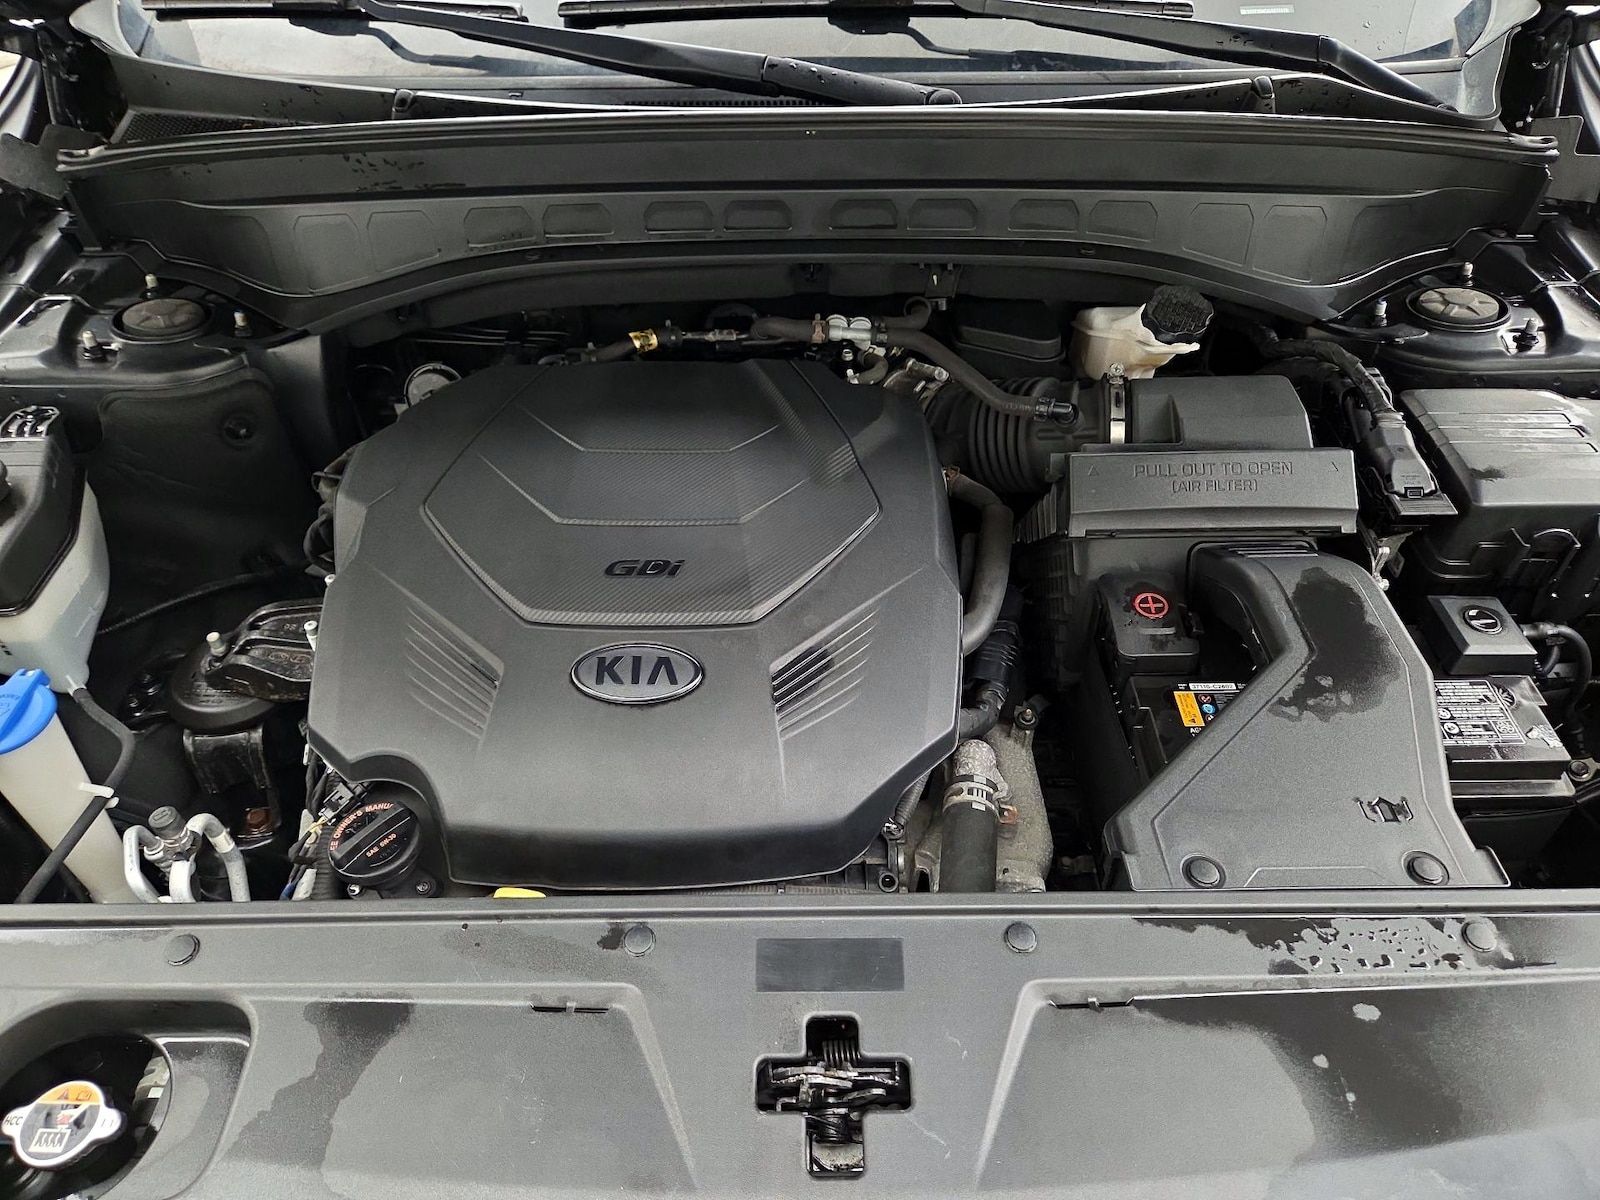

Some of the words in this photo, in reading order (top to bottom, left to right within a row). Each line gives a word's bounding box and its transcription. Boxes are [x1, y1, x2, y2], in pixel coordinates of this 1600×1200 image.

[1133, 463, 1177, 478] PULL
[1182, 462, 1216, 477] OUT
[1221, 462, 1244, 476] TO
[1248, 461, 1293, 475] OPEN
[1172, 480, 1202, 494] (AIR
[1205, 479, 1259, 493] FILTER)
[604, 559, 686, 577] GDi
[594, 655, 679, 686] KIA
[365, 803, 394, 812] MANU
[366, 846, 380, 857] SAE
[4, 1116, 23, 1126] HCC
